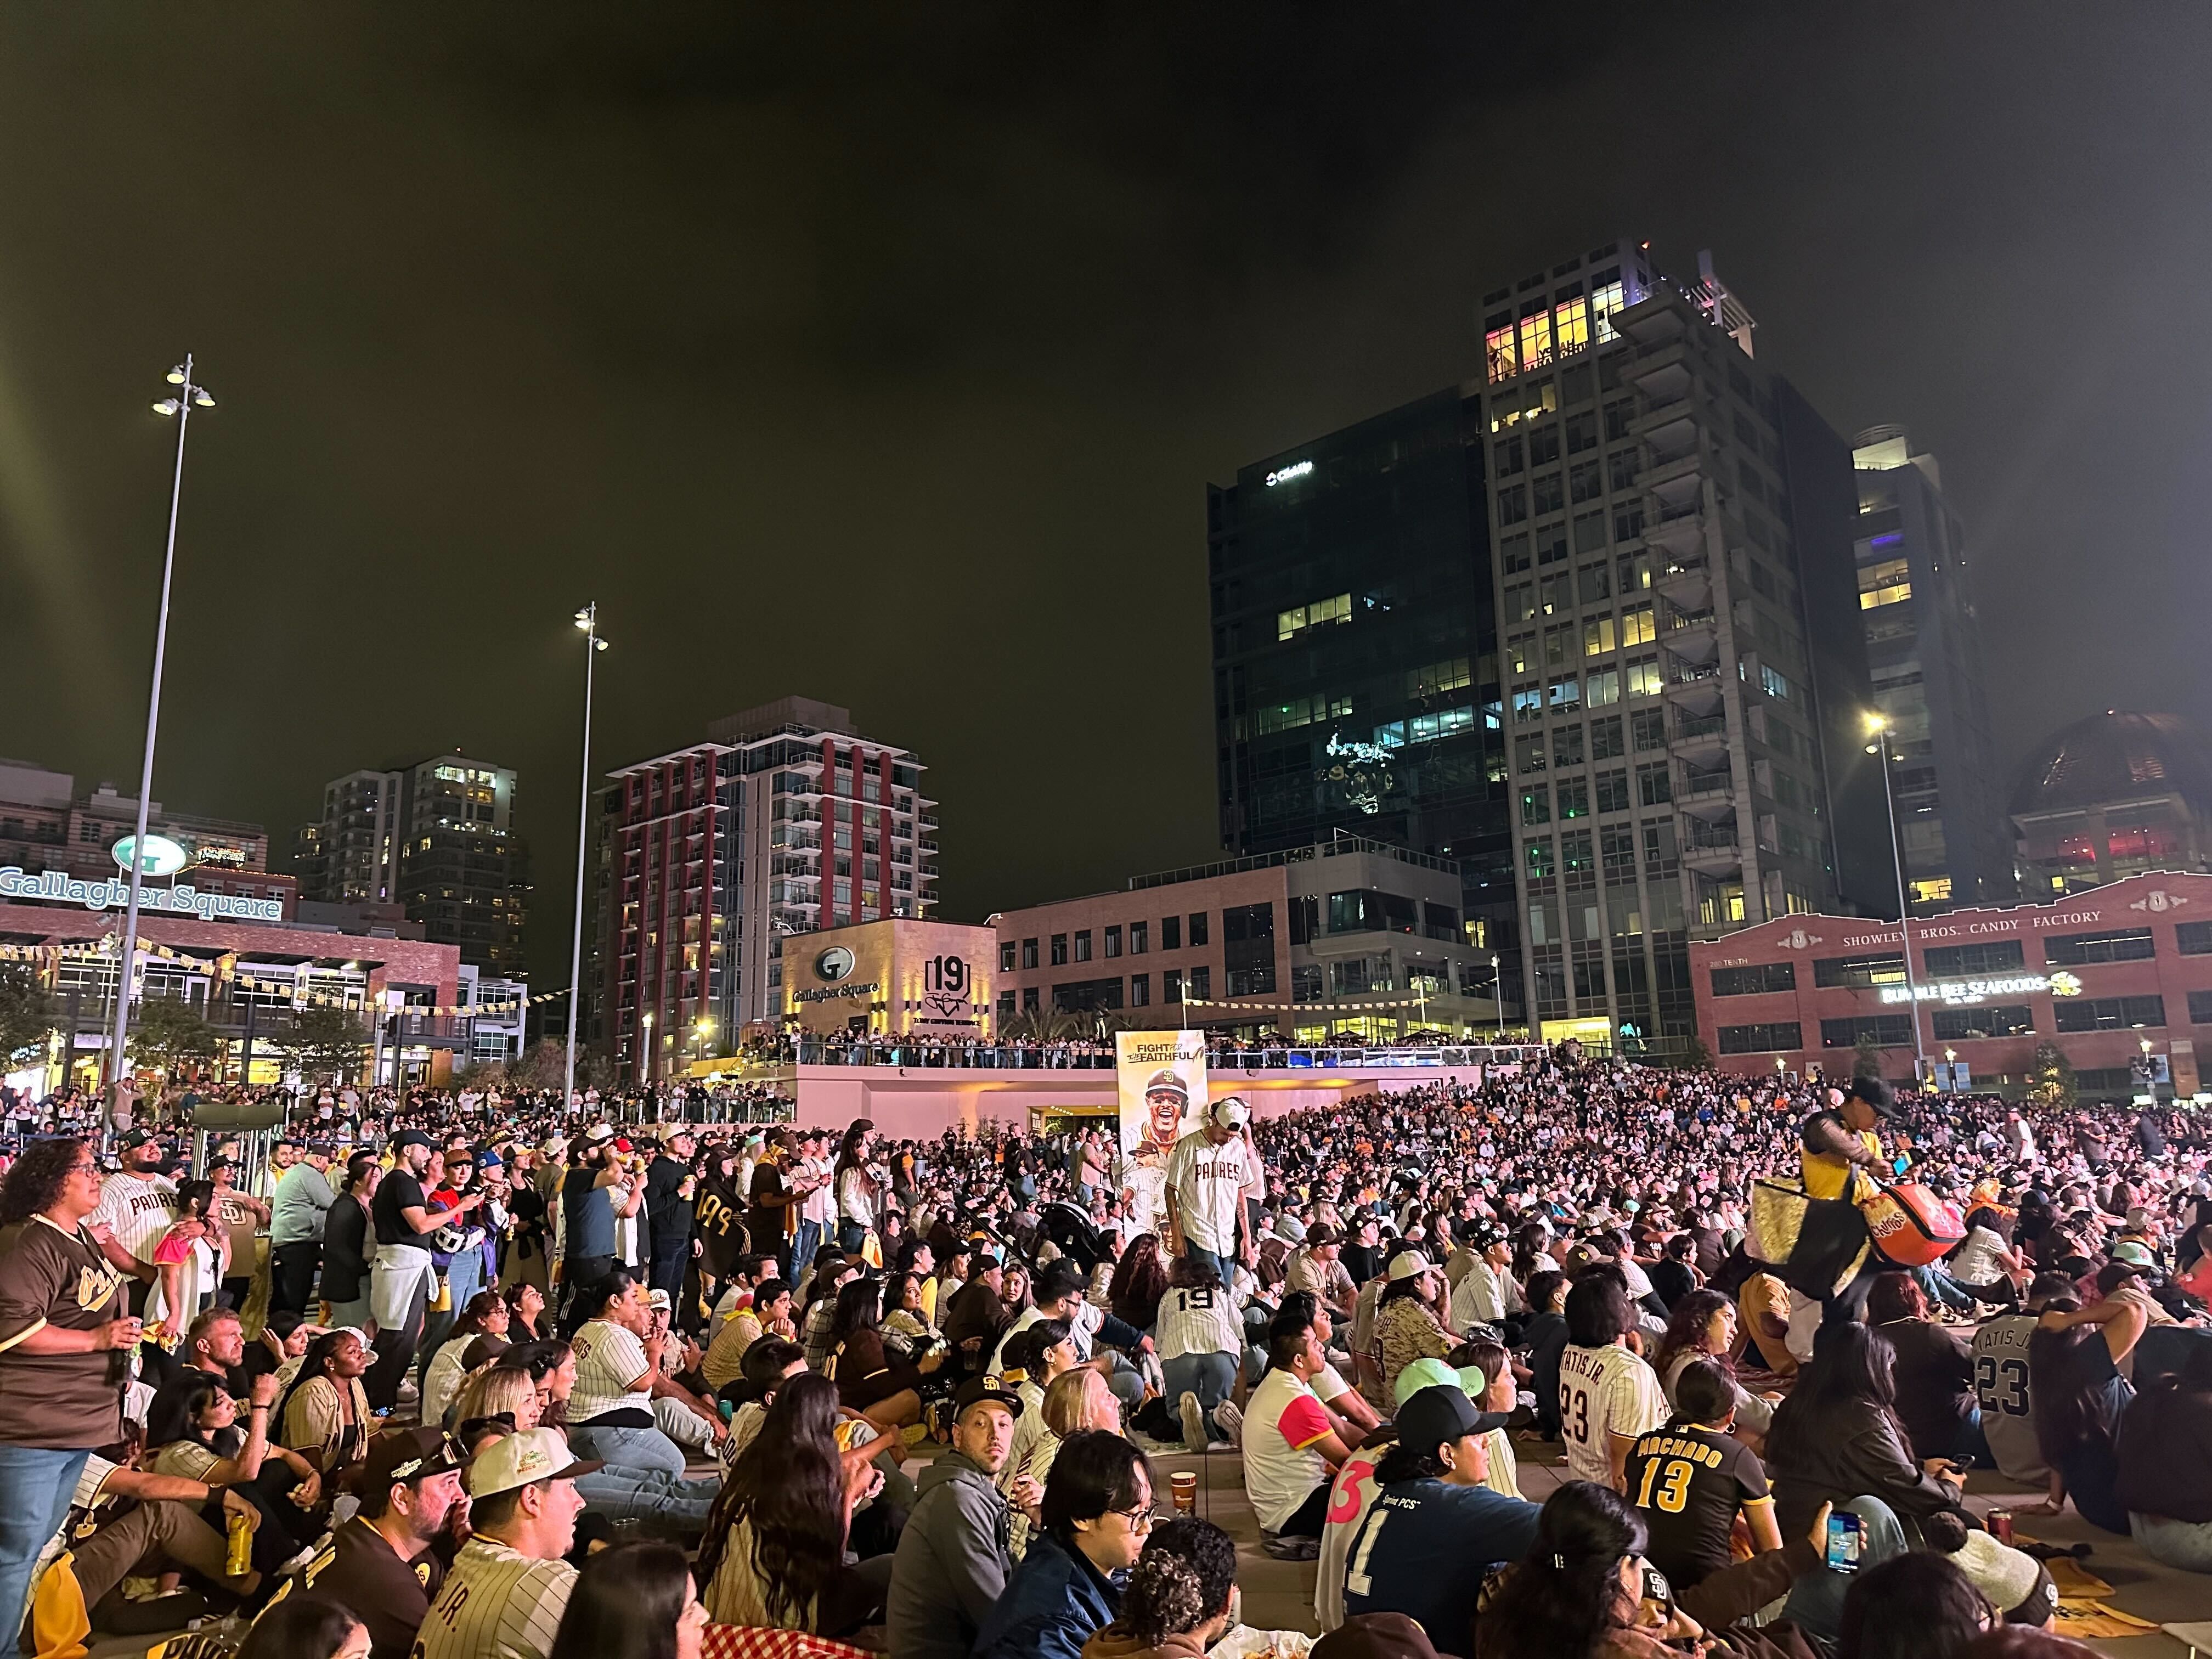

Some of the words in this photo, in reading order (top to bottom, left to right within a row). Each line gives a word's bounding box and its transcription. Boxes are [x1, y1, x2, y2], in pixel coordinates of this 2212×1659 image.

[0, 867, 167, 910] Gallagher
[171, 885, 282, 921] Square
[1843, 932, 1905, 947] SHOWLEY
[1921, 926, 1961, 939] BROS.
[1970, 919, 2019, 934] CANDY
[2033, 911, 2101, 927] FACTORY
[1723, 958, 1748, 967] TENTH
[842, 983, 880, 998] Square
[1940, 984, 1967, 998] BEE
[1968, 976, 2047, 996] SEAFOODS
[1137, 1043, 1170, 1053] FIGHT
[1140, 1052, 1194, 1062] FAITHFUL
[1195, 1161, 1239, 1182] PADRES
[129, 1192, 179, 1216] PADRE
[1870, 1211, 1906, 1238] Churros
[1177, 1288, 1214, 1311] 19
[1561, 1351, 1590, 1376] TATIS
[1585, 1360, 1605, 1386] JR.
[983, 1376, 1000, 1391] SD
[1977, 1356, 2029, 1417] 23
[1561, 1383, 1589, 1444] 23
[1637, 1436, 1723, 1469] MACHADO
[1635, 1457, 1694, 1513] 13
[1347, 1508, 1390, 1596] 1
[1649, 1572, 1667, 1600] SD
[438, 1581, 470, 1633] JR.
